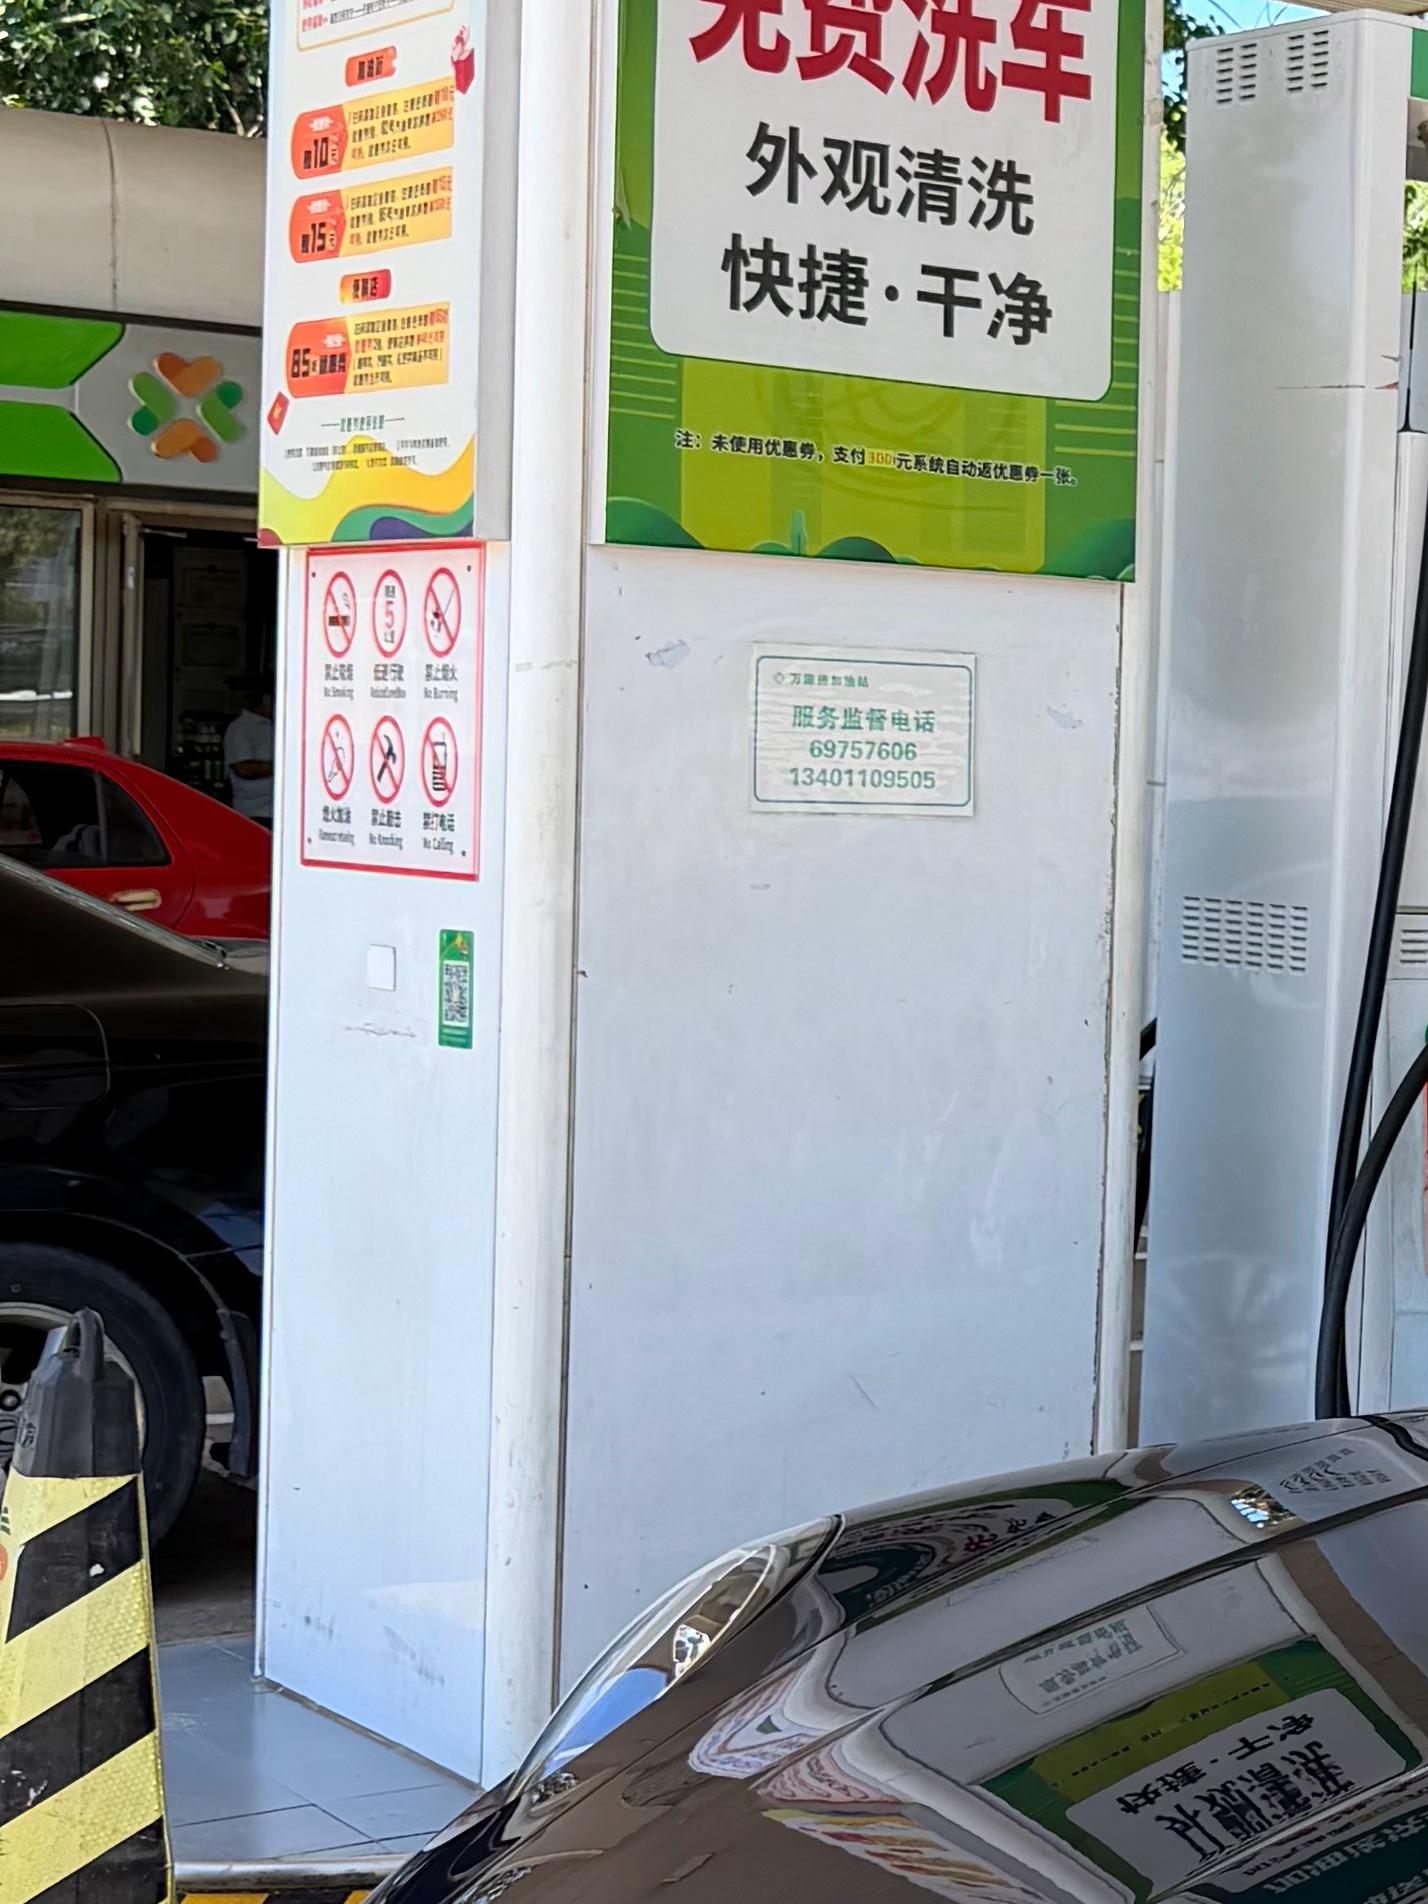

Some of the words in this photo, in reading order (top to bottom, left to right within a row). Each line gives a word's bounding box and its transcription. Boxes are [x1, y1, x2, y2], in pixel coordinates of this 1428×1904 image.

[746, 120, 1036, 237] 外观清洗
[720, 232, 1054, 347] 快捷·干净
[791, 704, 936, 734] 服务监督电话
[809, 739, 918, 761] 69757606
[789, 767, 936, 790] 13401109505
